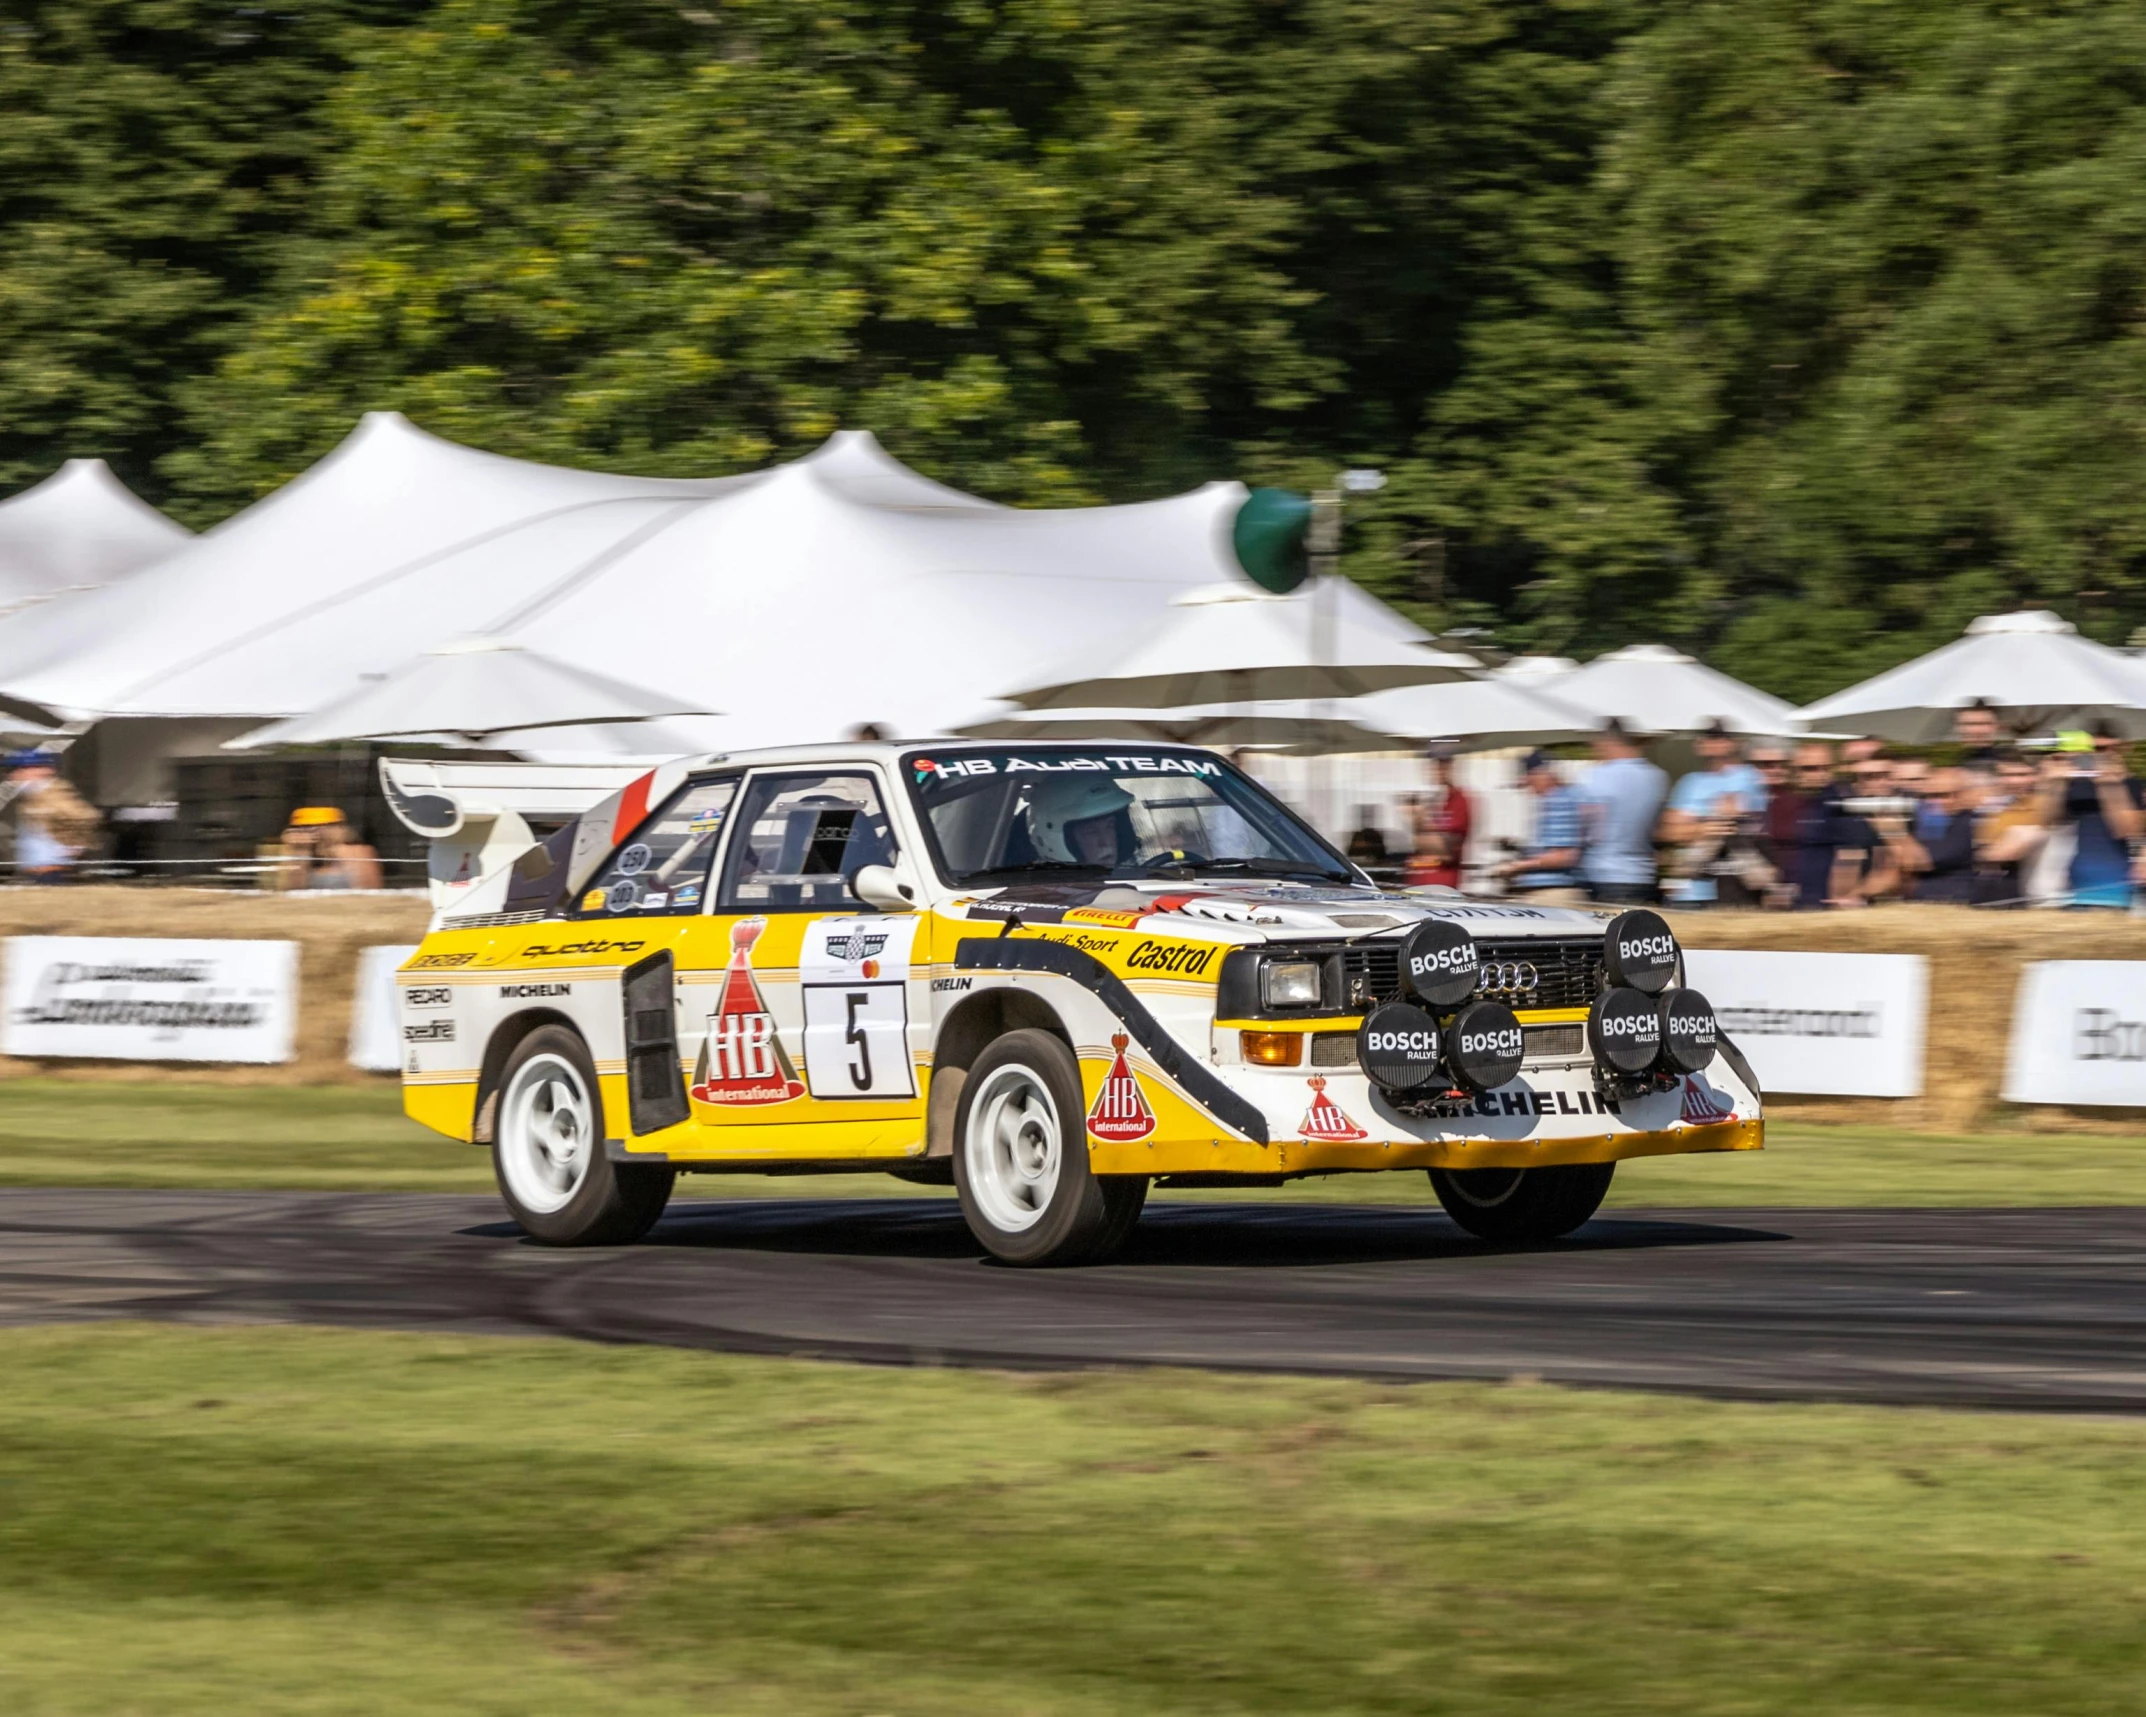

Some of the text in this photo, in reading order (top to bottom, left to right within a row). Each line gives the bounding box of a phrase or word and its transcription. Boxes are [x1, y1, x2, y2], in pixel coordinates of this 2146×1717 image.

[936, 759, 997, 779] HB
[1105, 757, 1223, 776] TEAM
[813, 827, 859, 838] parco
[1073, 909, 1131, 921] PIRELLI
[521, 939, 646, 958] quattro
[1074, 934, 1120, 953] Sport
[1619, 934, 1674, 959] BOSCH
[1126, 940, 1219, 975] Castrol
[1410, 943, 1477, 976] BOSCH
[1651, 953, 1675, 964] RALLYE
[1450, 961, 1478, 975] RALLYE
[500, 983, 571, 998] MICHELIN
[1602, 1013, 1659, 1036] BOSCH
[1669, 1015, 1716, 1035] BOSCH
[706, 1010, 776, 1081] HB
[846, 992, 873, 1091] 5
[1368, 1032, 1437, 1050] BOSCH
[1462, 1028, 1522, 1052] BOSCH
[1635, 1032, 1660, 1042] RALLYE
[1695, 1034, 1716, 1044] RALLYE
[1407, 1051, 1437, 1060] RALLYE
[1496, 1047, 1522, 1057] RALLYE
[706, 1084, 790, 1102] international
[1104, 1077, 1137, 1118] HB
[1094, 1120, 1147, 1132] international
[1307, 1107, 1347, 1131] HB
